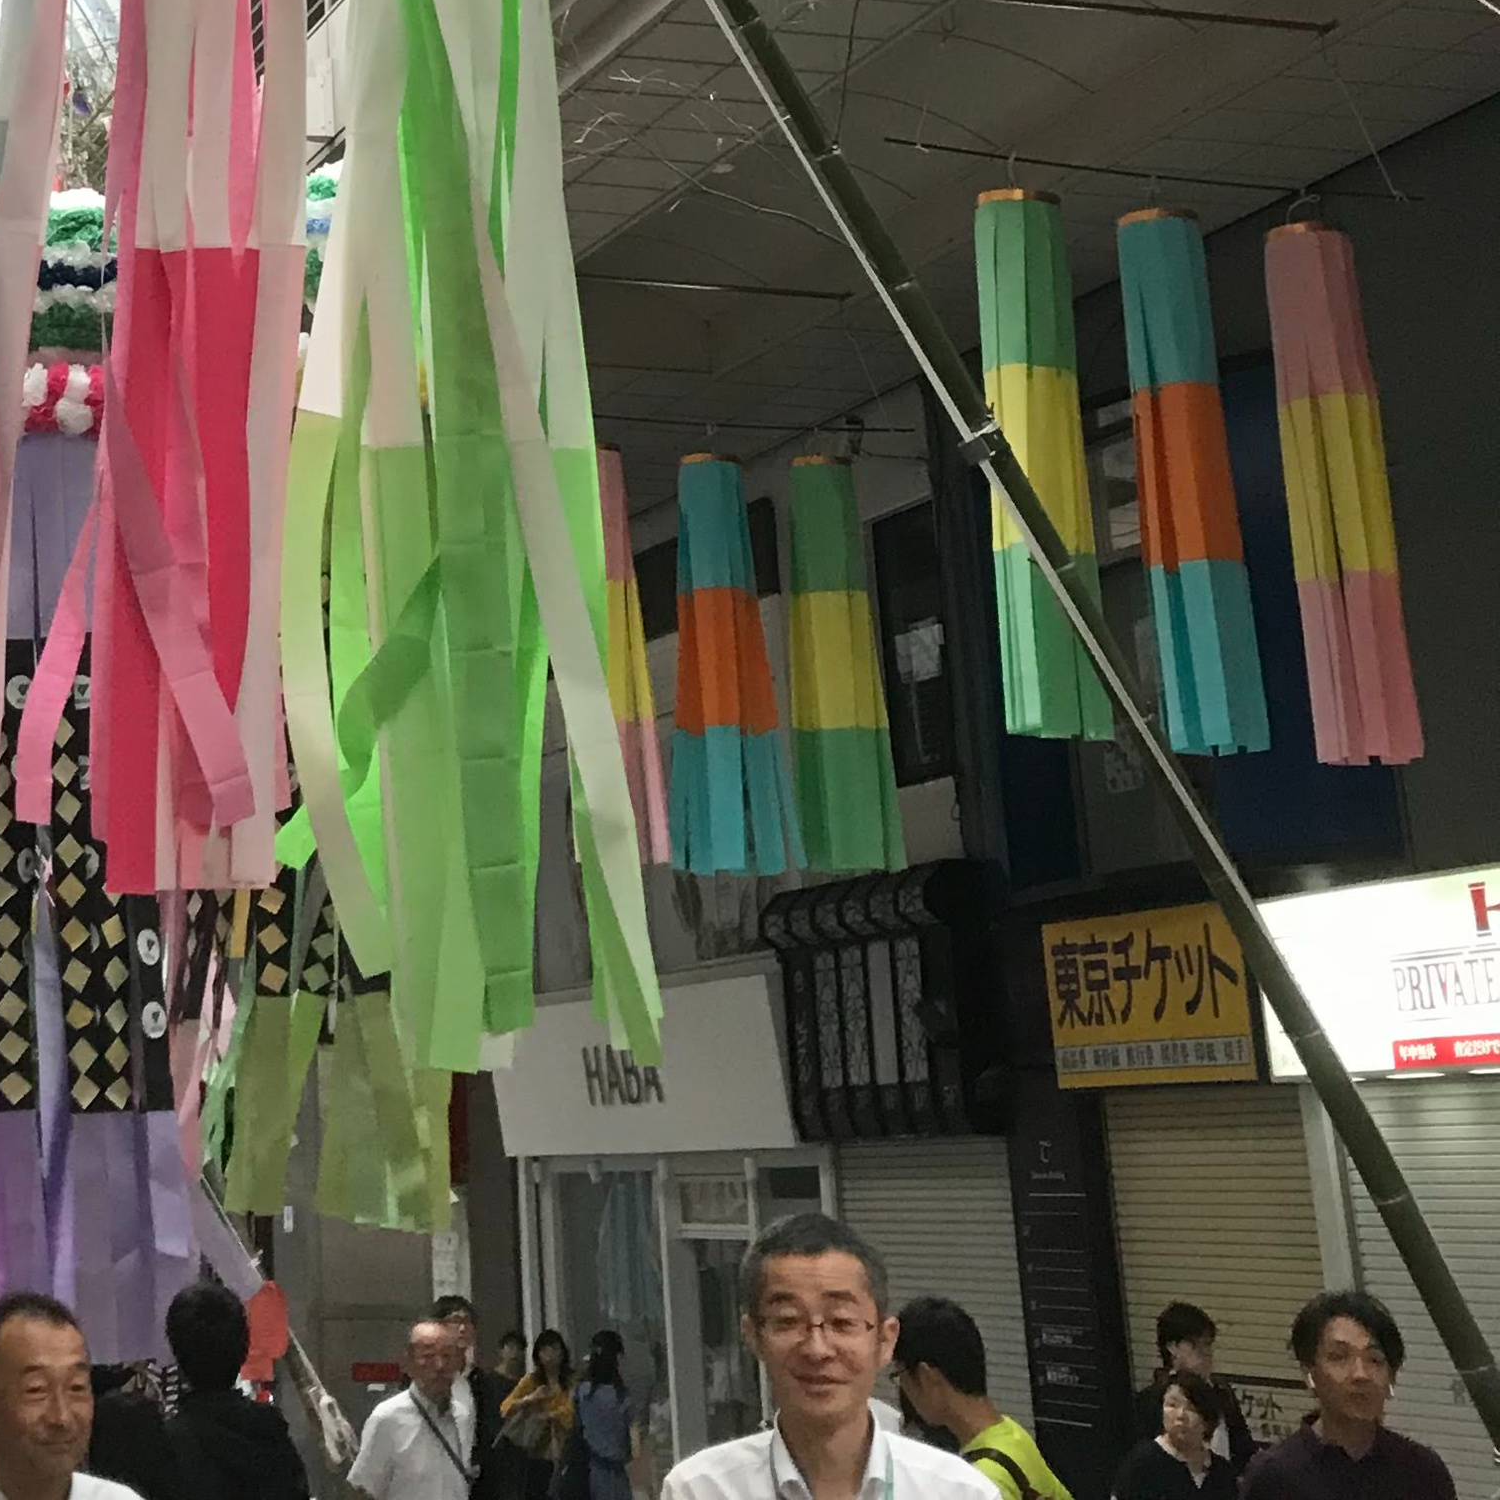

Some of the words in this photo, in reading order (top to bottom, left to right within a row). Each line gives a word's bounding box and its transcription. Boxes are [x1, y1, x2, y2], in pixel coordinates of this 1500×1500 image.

[1051, 922, 1239, 1030] 東京チケット
[1392, 957, 1500, 1011] PRIVATE
